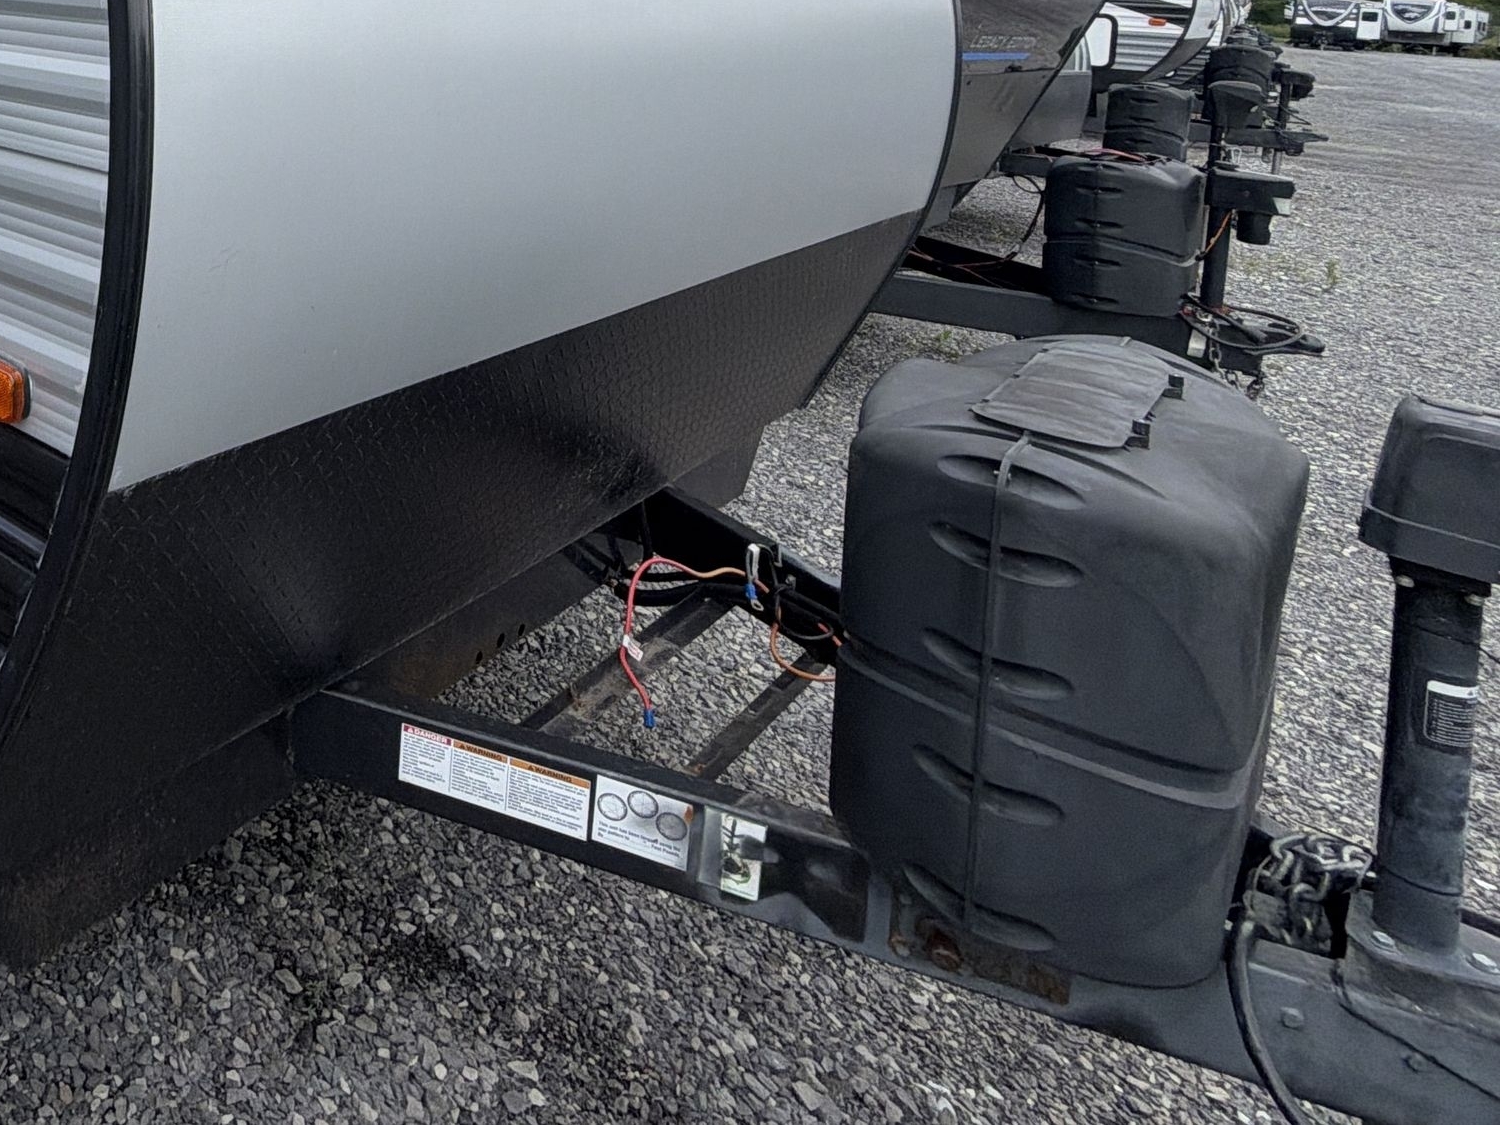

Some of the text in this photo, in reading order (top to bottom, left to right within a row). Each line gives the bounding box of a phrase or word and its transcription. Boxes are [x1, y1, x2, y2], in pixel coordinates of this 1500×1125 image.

[414, 728, 448, 745] DANGER
[466, 745, 504, 762] WARNING
[535, 766, 573, 784] WARNING
